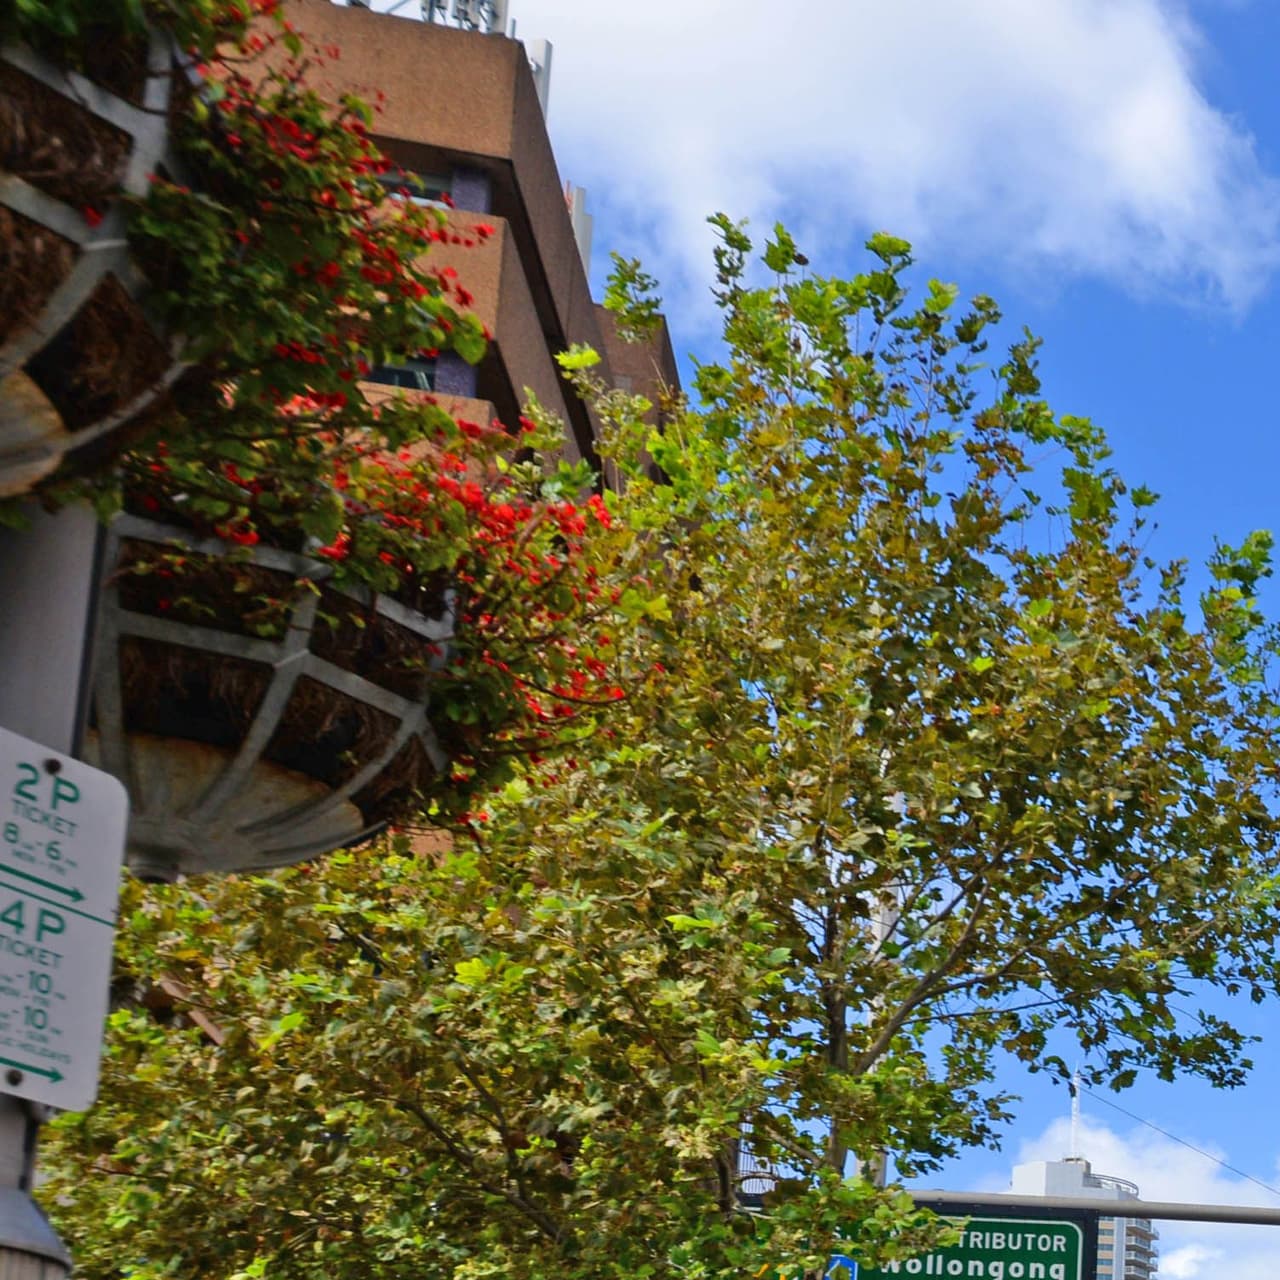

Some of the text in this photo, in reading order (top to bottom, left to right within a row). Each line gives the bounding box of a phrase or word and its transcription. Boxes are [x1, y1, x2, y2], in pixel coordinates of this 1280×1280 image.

[14, 762, 80, 810] 2P
[0, 900, 66, 942] 4P
[957, 1229, 1067, 1252] TRIBUTOR
